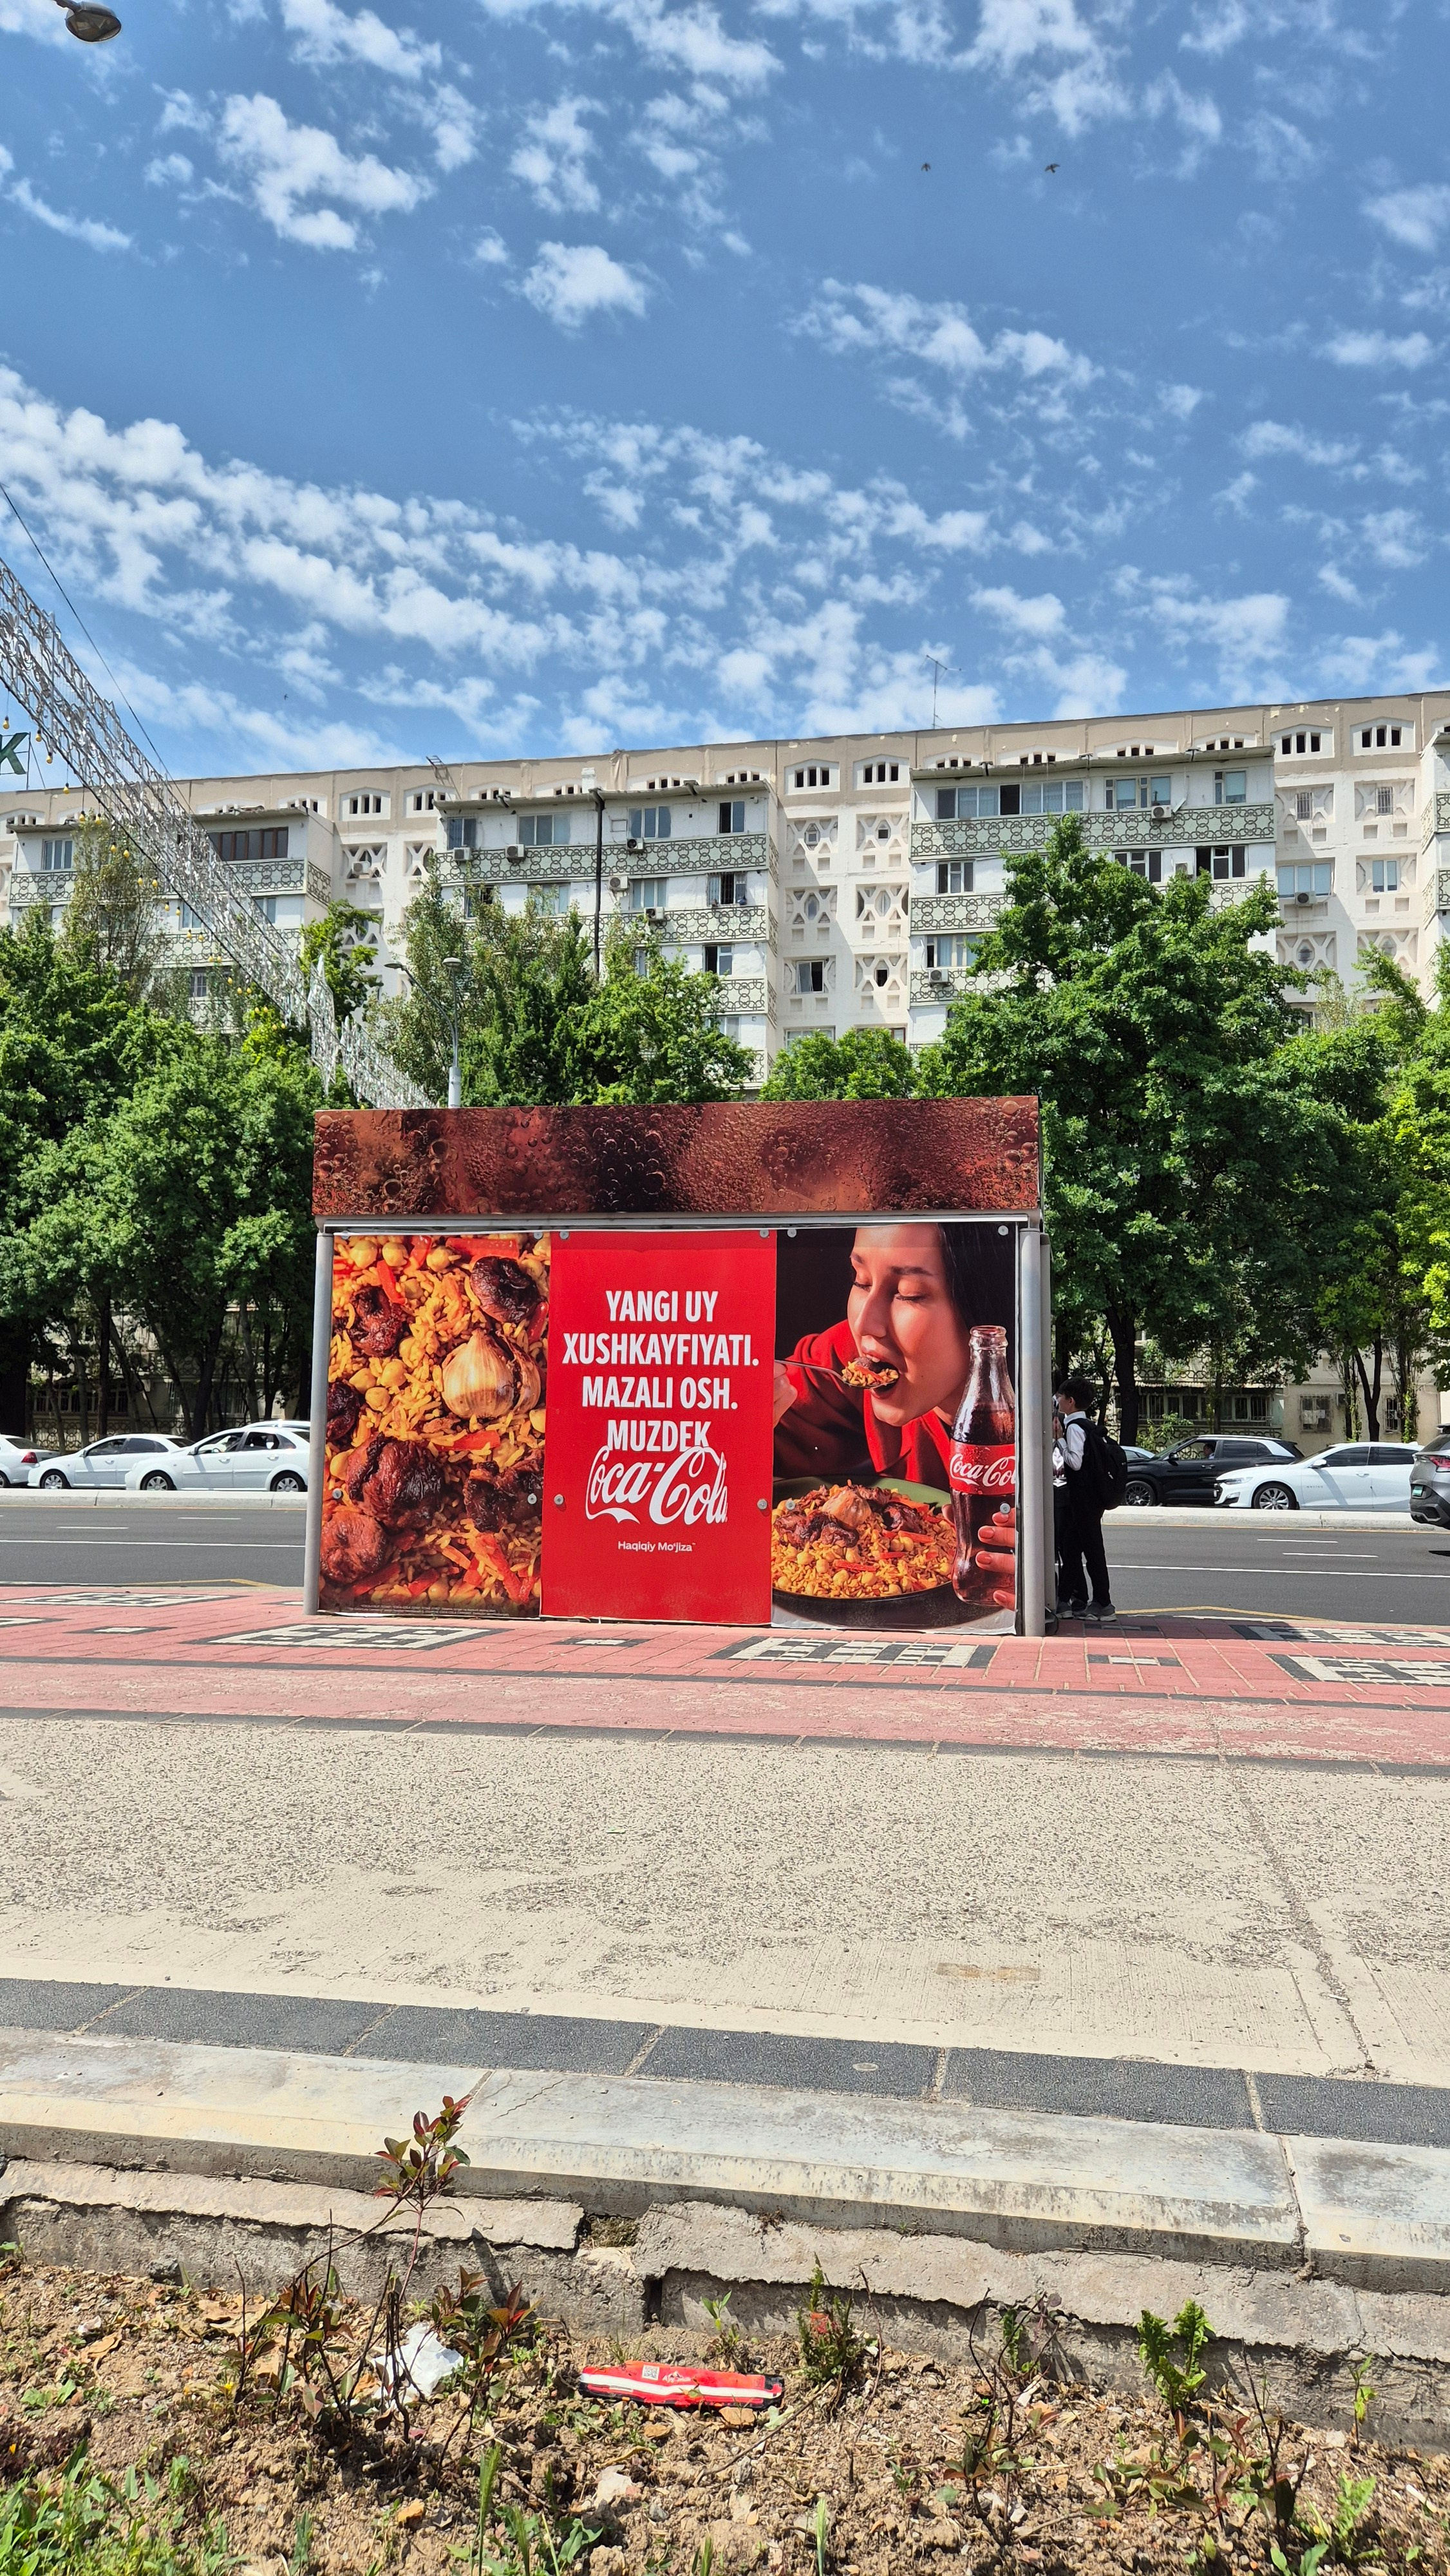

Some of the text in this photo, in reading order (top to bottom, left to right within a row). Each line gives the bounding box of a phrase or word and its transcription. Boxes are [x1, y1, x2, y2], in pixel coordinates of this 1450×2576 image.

[606, 1291, 719, 1322] YANGI UY
[562, 1333, 759, 1366] XUSHKAYFIYATI.
[582, 1376, 738, 1409] MAZALI OSH.
[607, 1419, 711, 1452] MUZDEK
[585, 1445, 728, 1525] Coca-Cola
[617, 1540, 656, 1552] Haqiqiy
